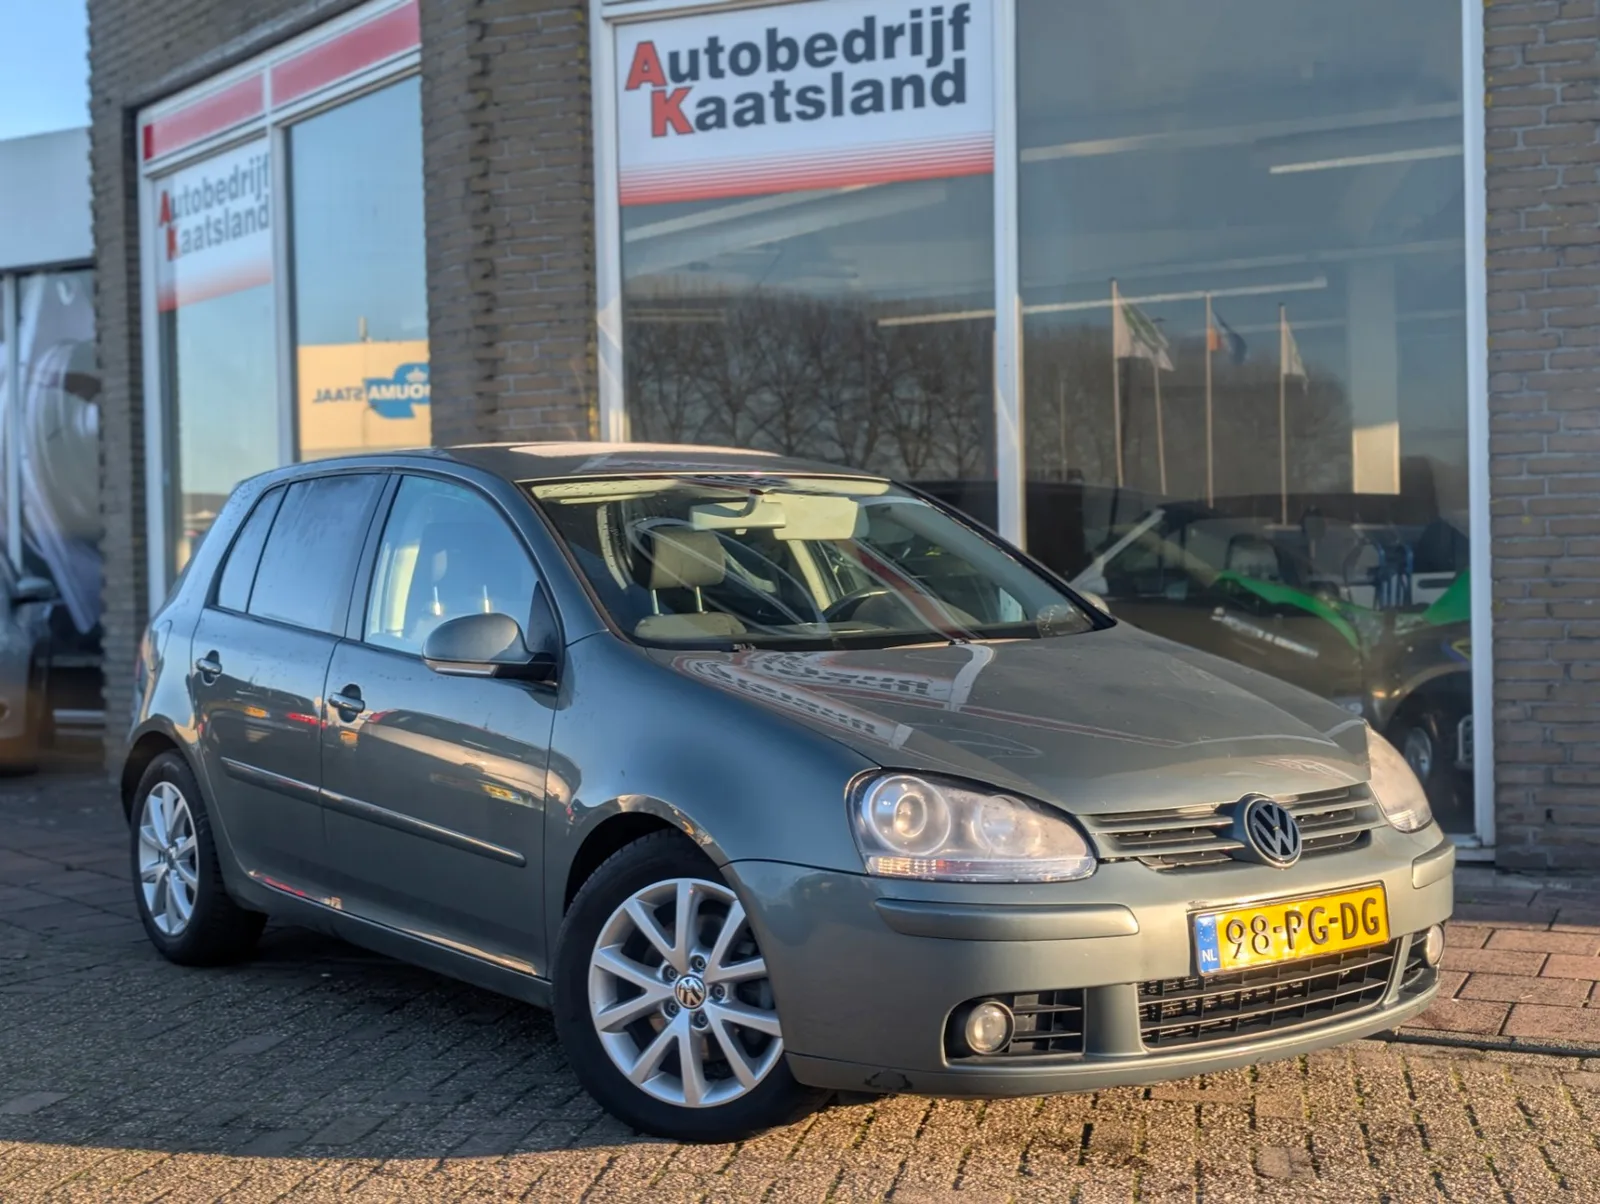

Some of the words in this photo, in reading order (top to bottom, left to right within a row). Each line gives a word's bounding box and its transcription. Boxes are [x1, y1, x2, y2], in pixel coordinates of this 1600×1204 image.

[625, 3, 971, 91] Autobedrijf
[651, 58, 967, 138] Kaatsland
[1202, 950, 1218, 962] NL
[1226, 897, 1380, 959] 98-PG-DG
